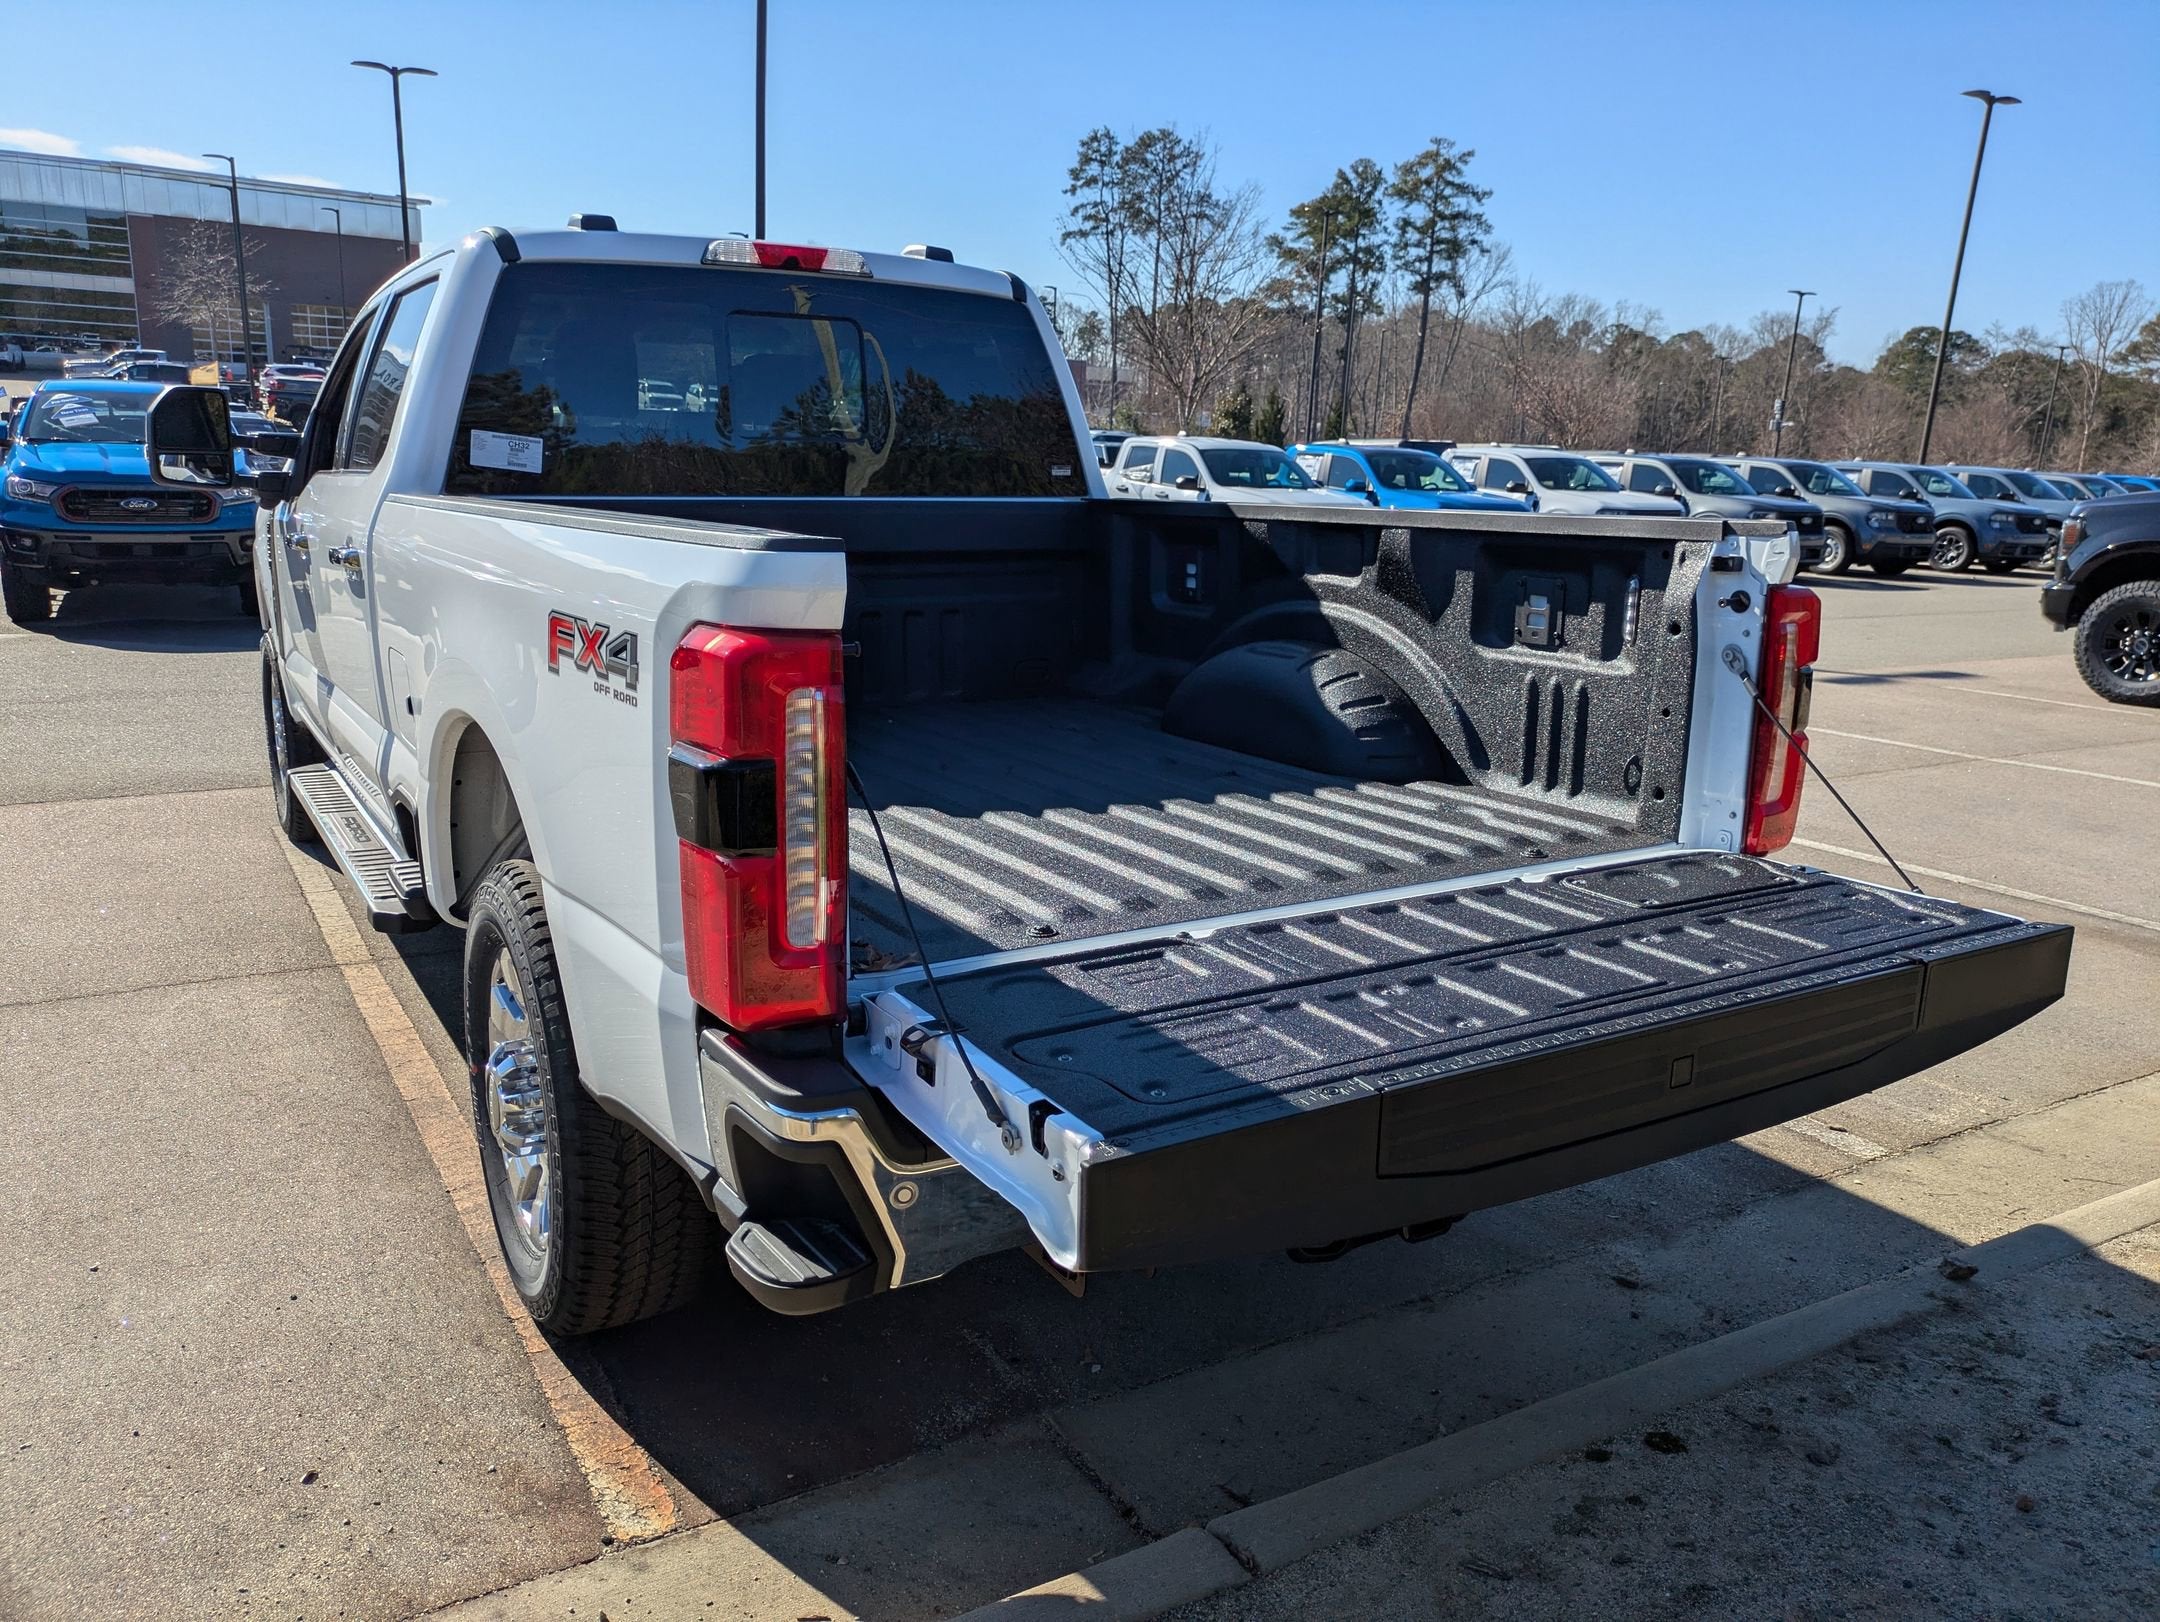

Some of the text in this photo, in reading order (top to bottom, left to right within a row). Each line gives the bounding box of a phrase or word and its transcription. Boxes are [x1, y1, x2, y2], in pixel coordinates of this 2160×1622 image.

[508, 440, 530, 450] CH32
[547, 608, 639, 693] FX4
[593, 682, 638, 707] OFF ROAD
